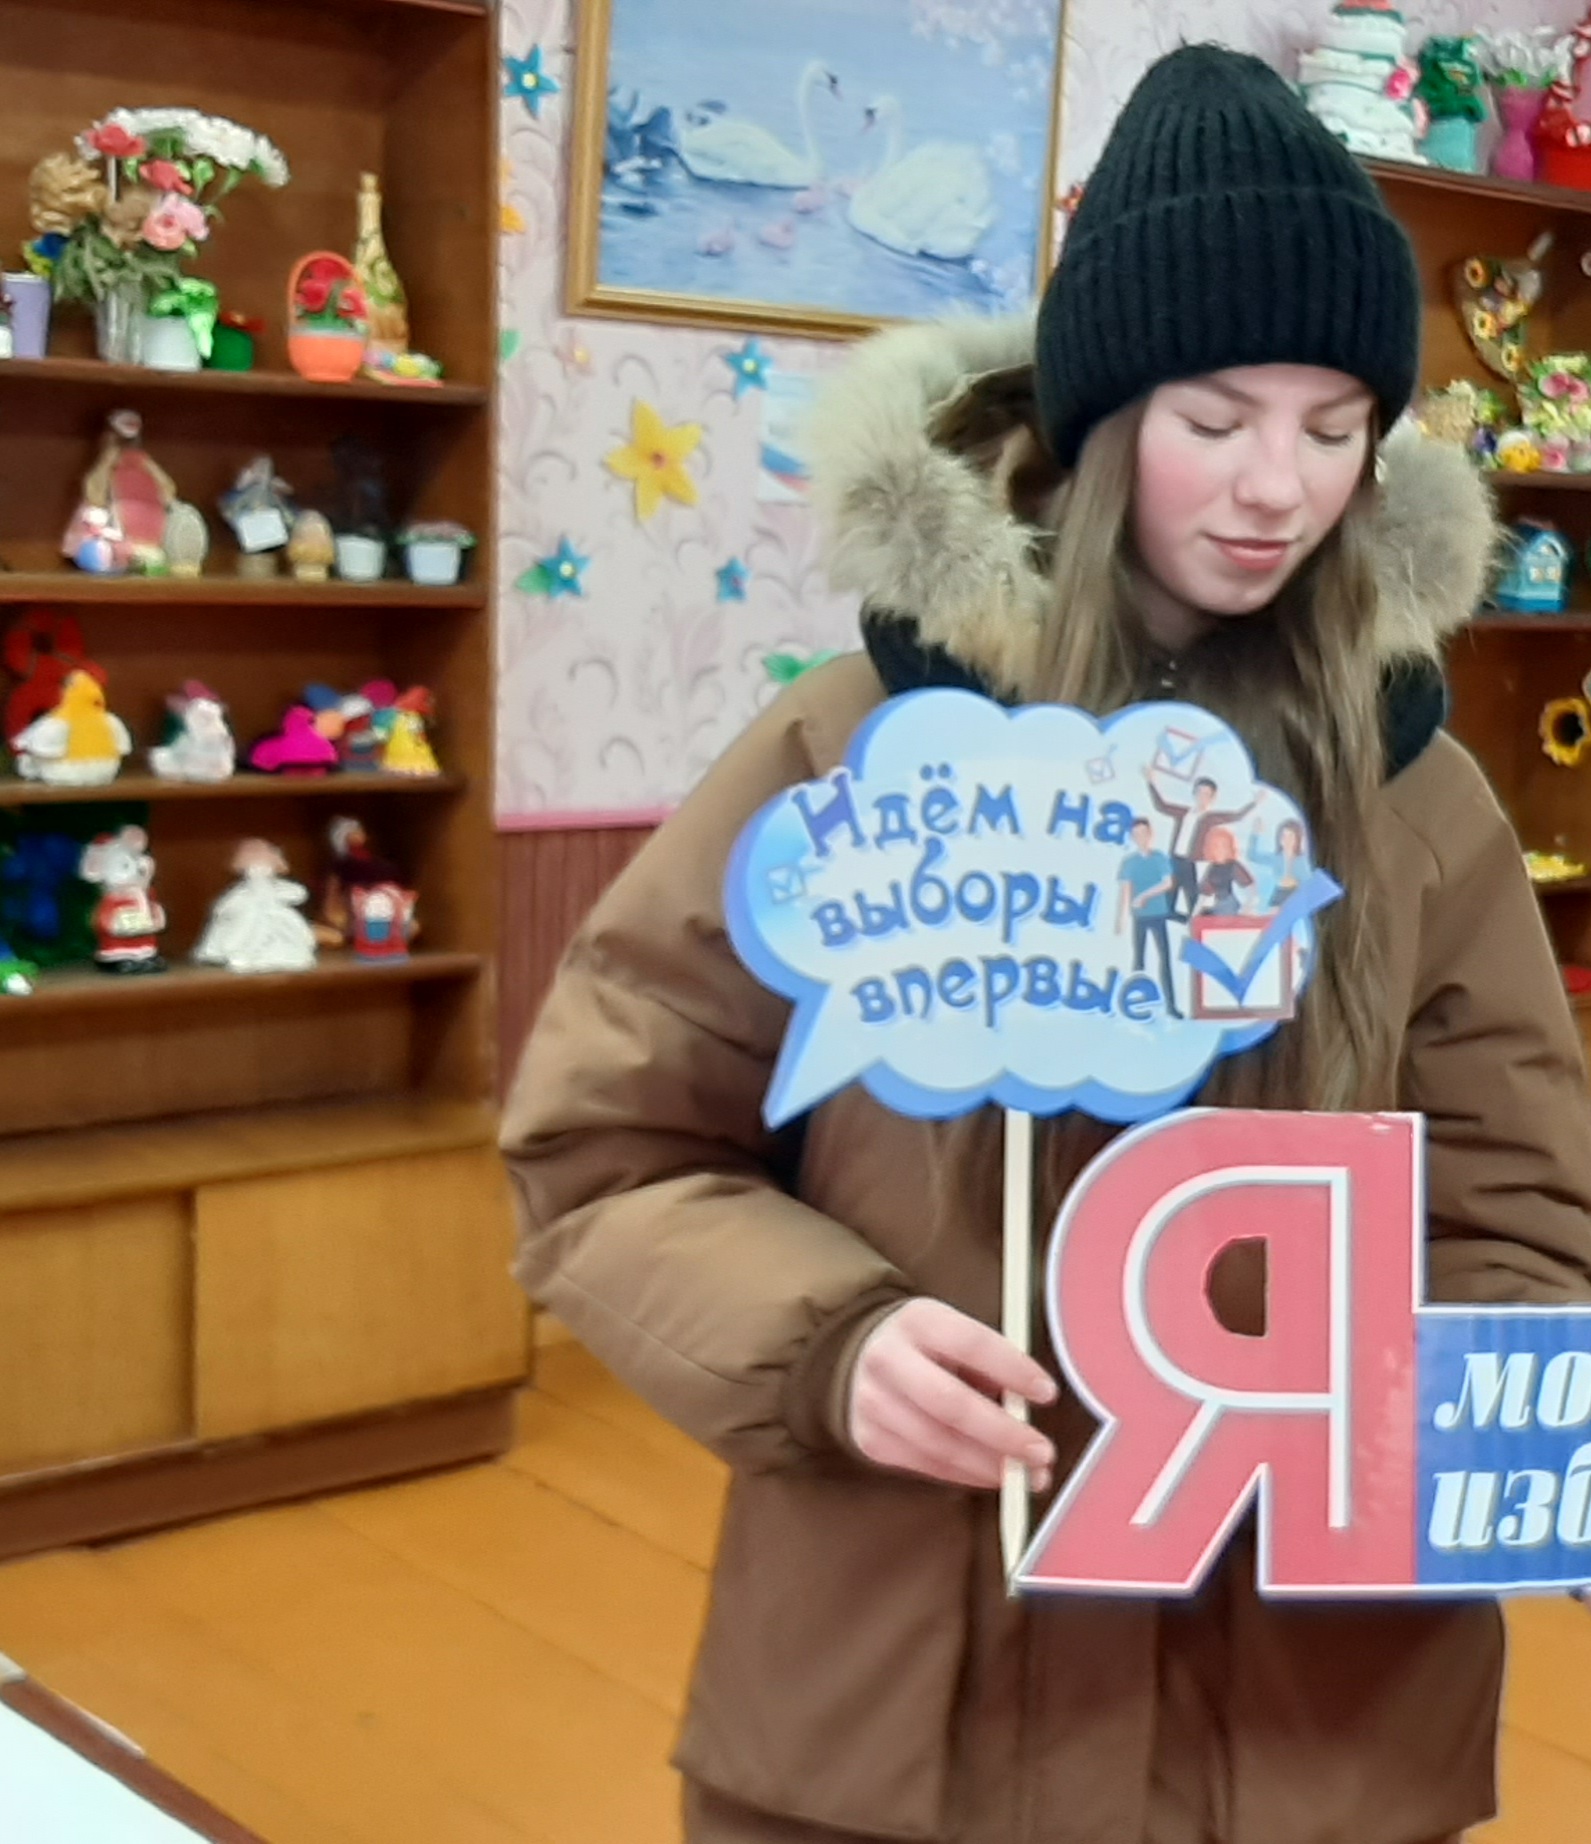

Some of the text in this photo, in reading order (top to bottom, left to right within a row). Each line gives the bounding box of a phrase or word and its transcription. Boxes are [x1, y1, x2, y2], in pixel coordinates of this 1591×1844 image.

[1046, 790, 1136, 846] на
[810, 836, 1099, 948] выборы
[850, 950, 1162, 1032] впервые
[1014, 1108, 1424, 1596] Я
